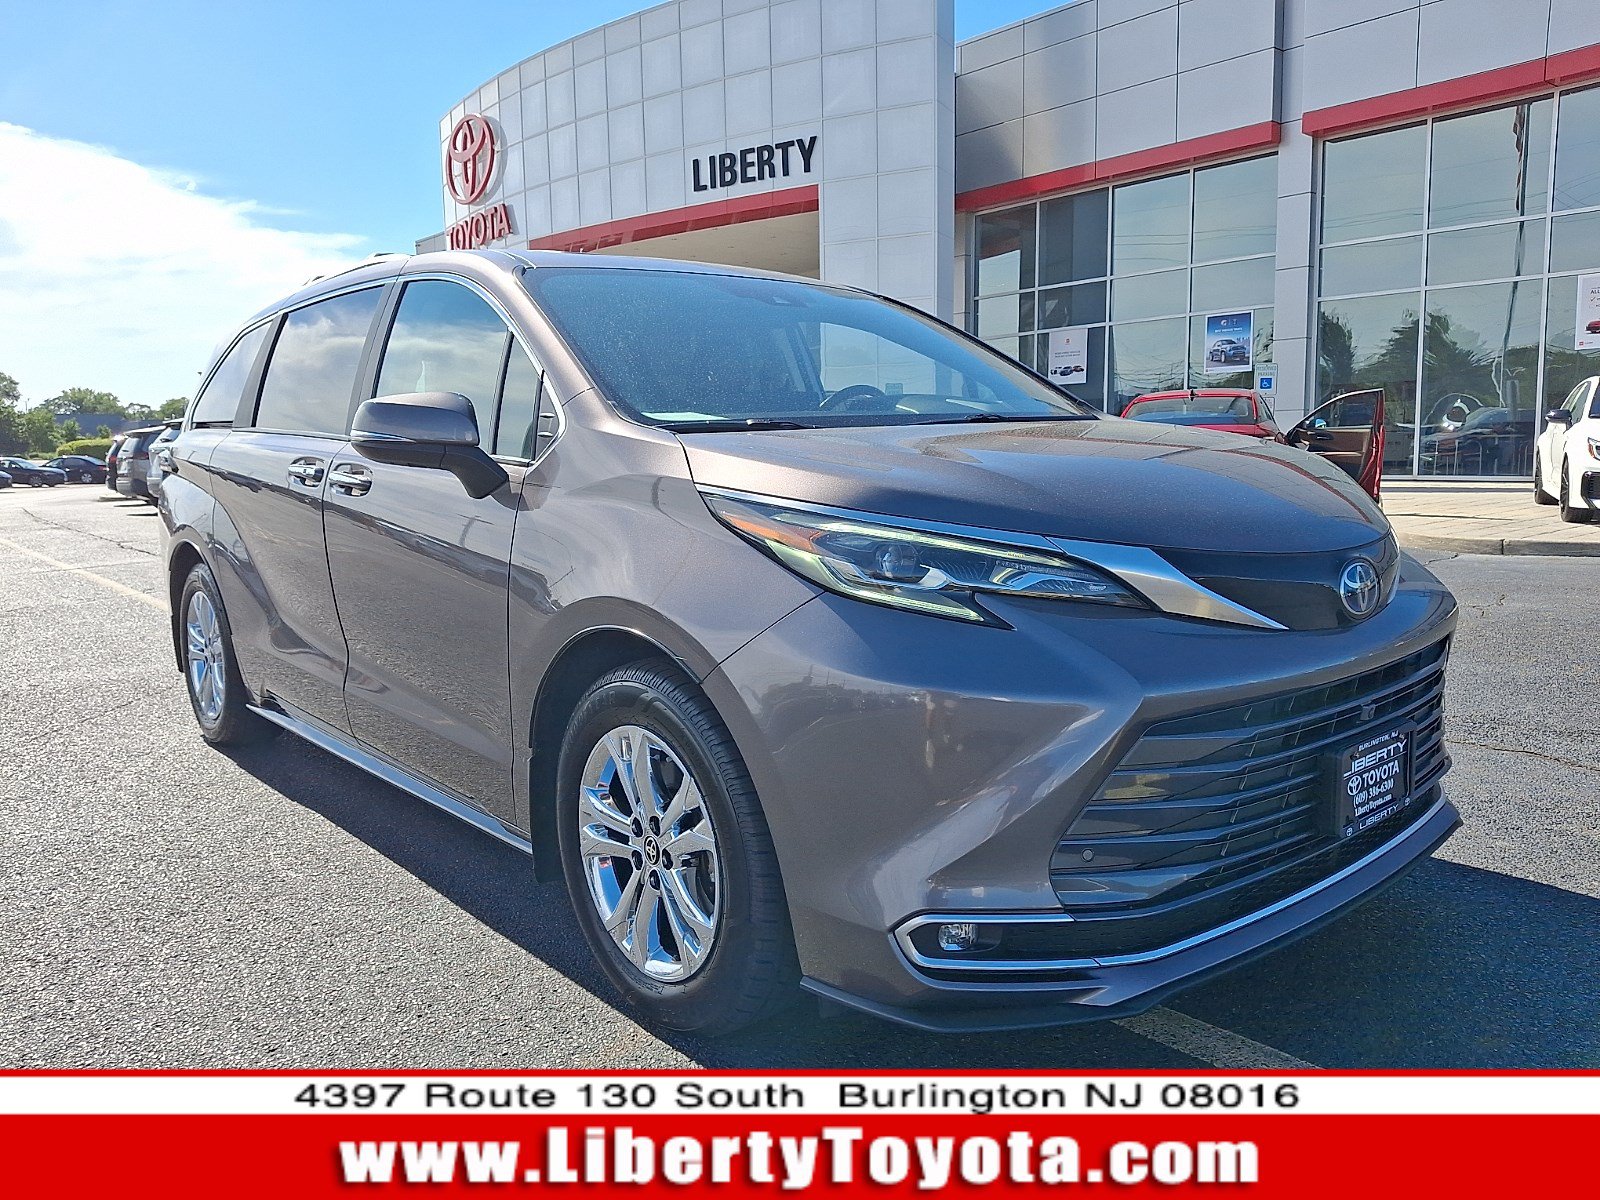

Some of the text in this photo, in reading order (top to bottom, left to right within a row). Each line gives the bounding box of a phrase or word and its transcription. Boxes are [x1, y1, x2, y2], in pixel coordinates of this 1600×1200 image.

[692, 135, 818, 192] LIBERTY
[445, 203, 514, 250] TOYOTA
[1362, 760, 1400, 788] TOYOTA
[1359, 804, 1399, 830] LIBERTY
